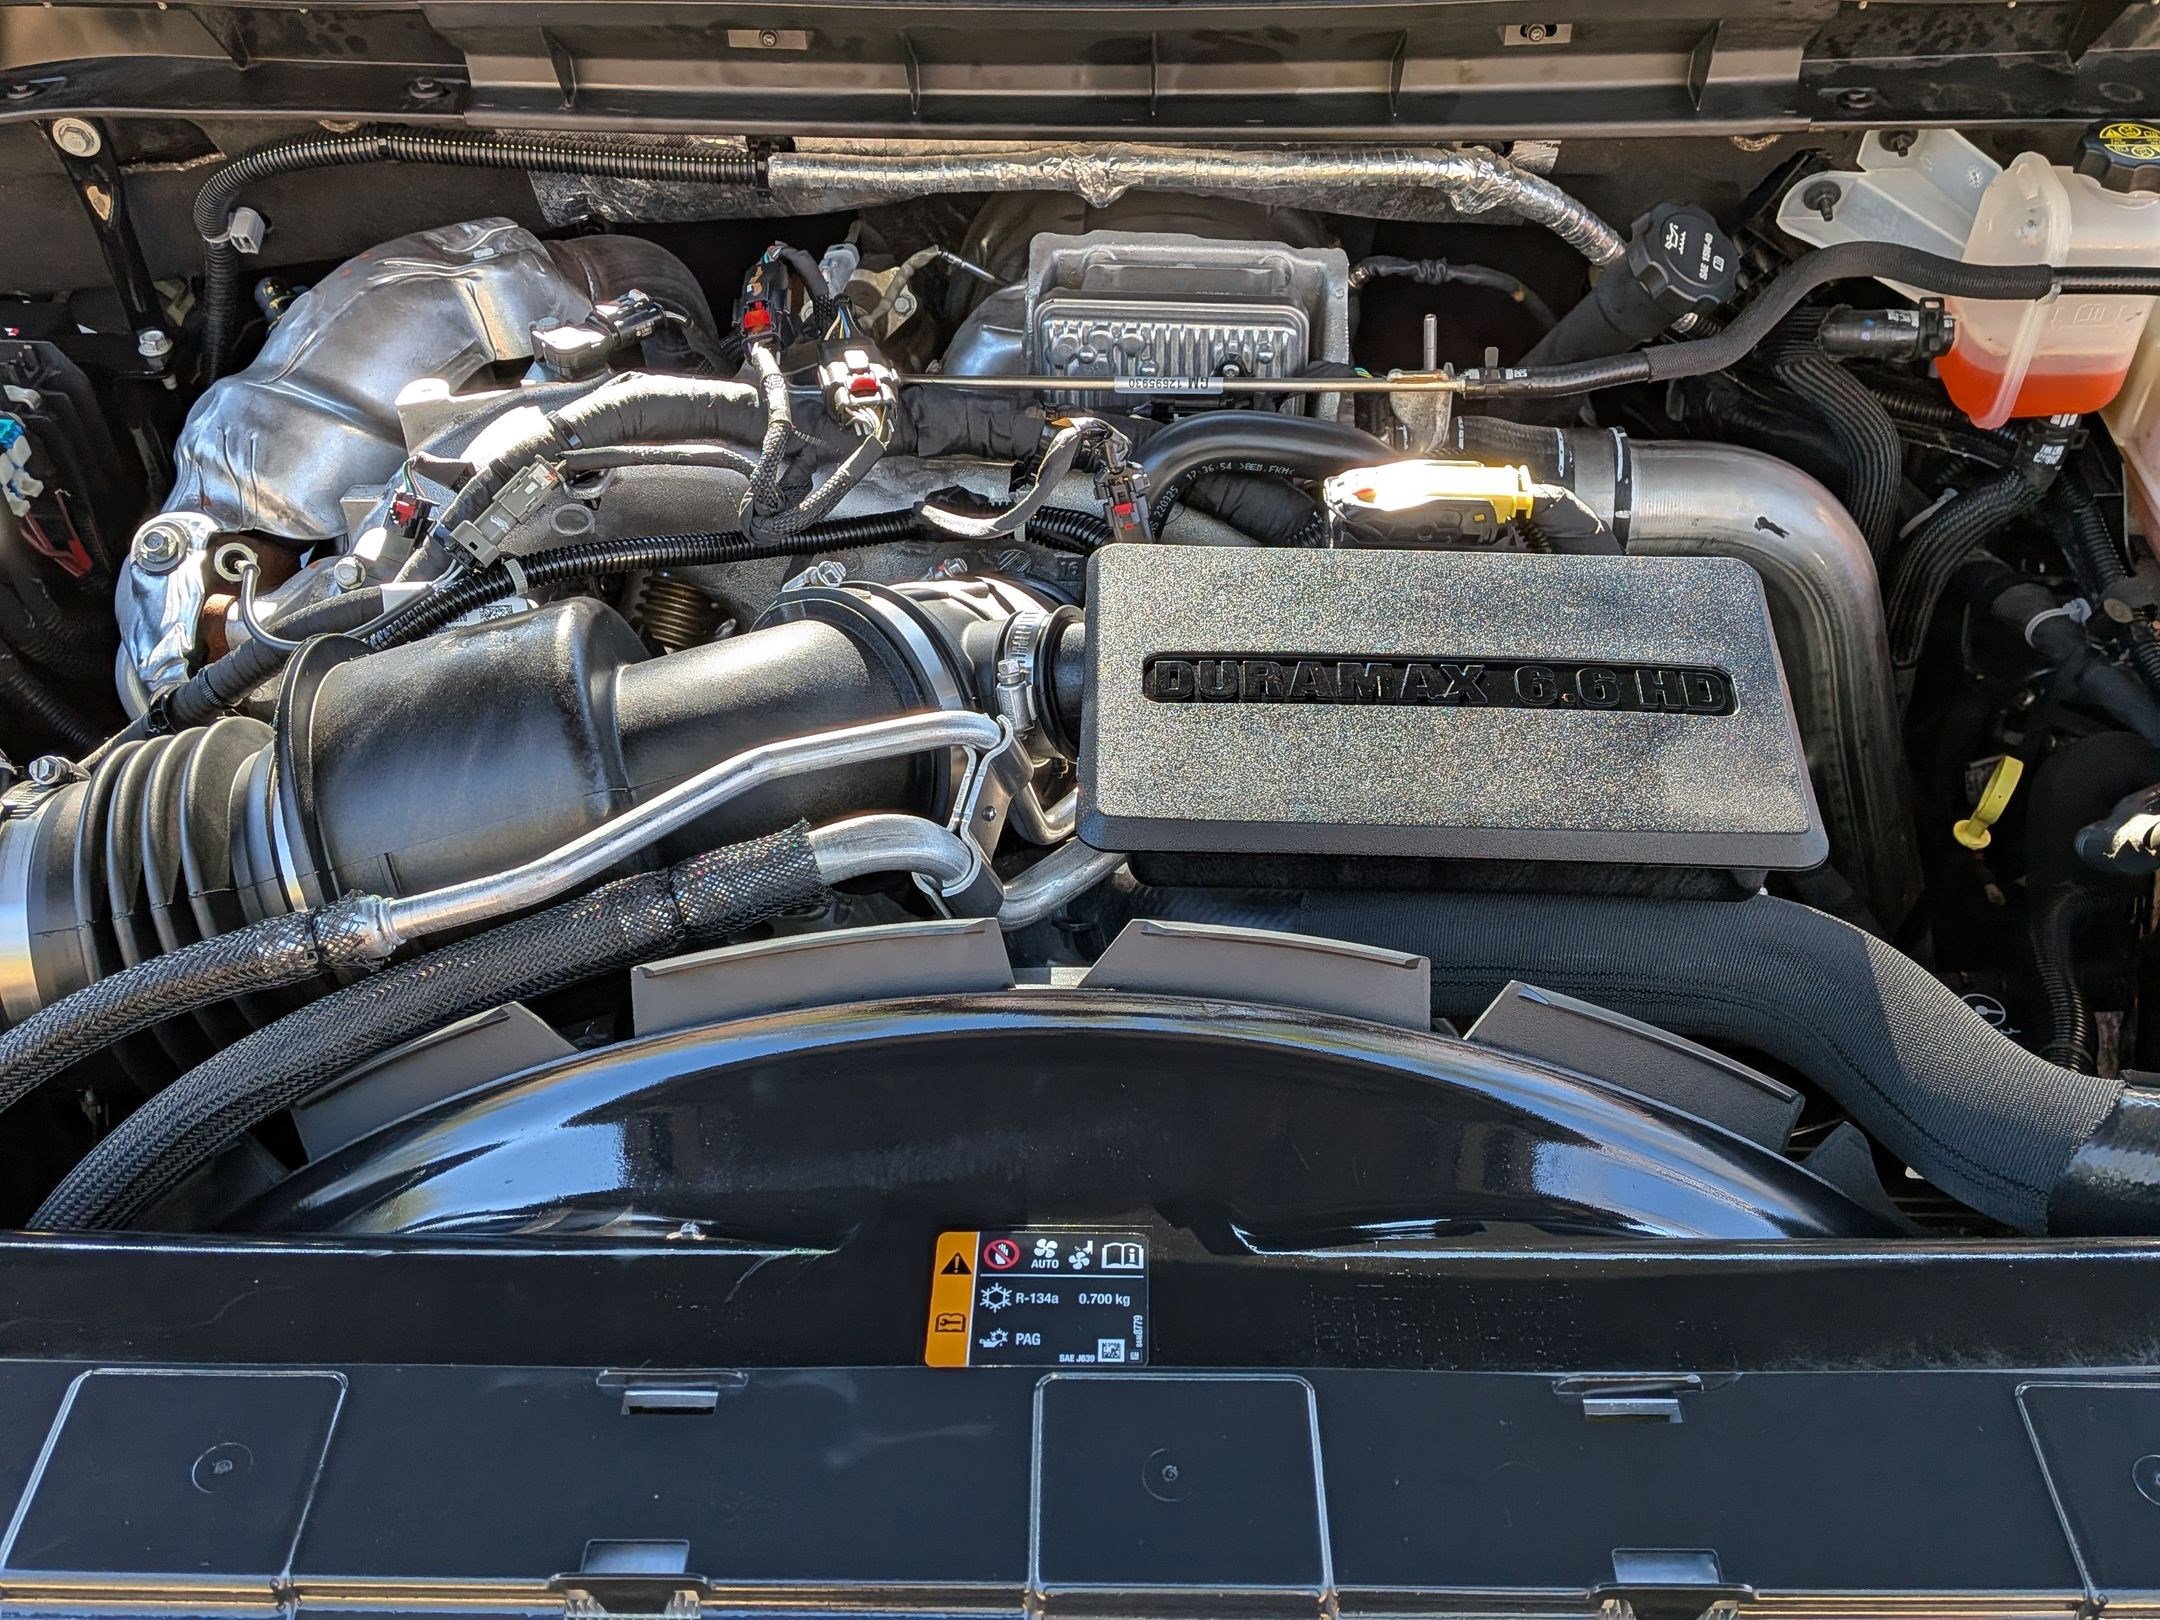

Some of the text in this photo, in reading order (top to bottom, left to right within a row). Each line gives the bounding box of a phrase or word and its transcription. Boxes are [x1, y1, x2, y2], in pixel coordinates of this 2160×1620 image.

[1699, 232, 1713, 280] SAE 15W-40
[1128, 377, 1209, 389] GM 12695930
[1153, 485, 1179, 518] 220325
[1153, 659, 1732, 713] DURAMAX 6.6 HD
[1031, 1259, 1059, 1269] AUTO
[1015, 1293, 1131, 1306] R-134a 0.700 kg
[1015, 1333, 1041, 1345] PAG
[1059, 1353, 1075, 1363] SAE
